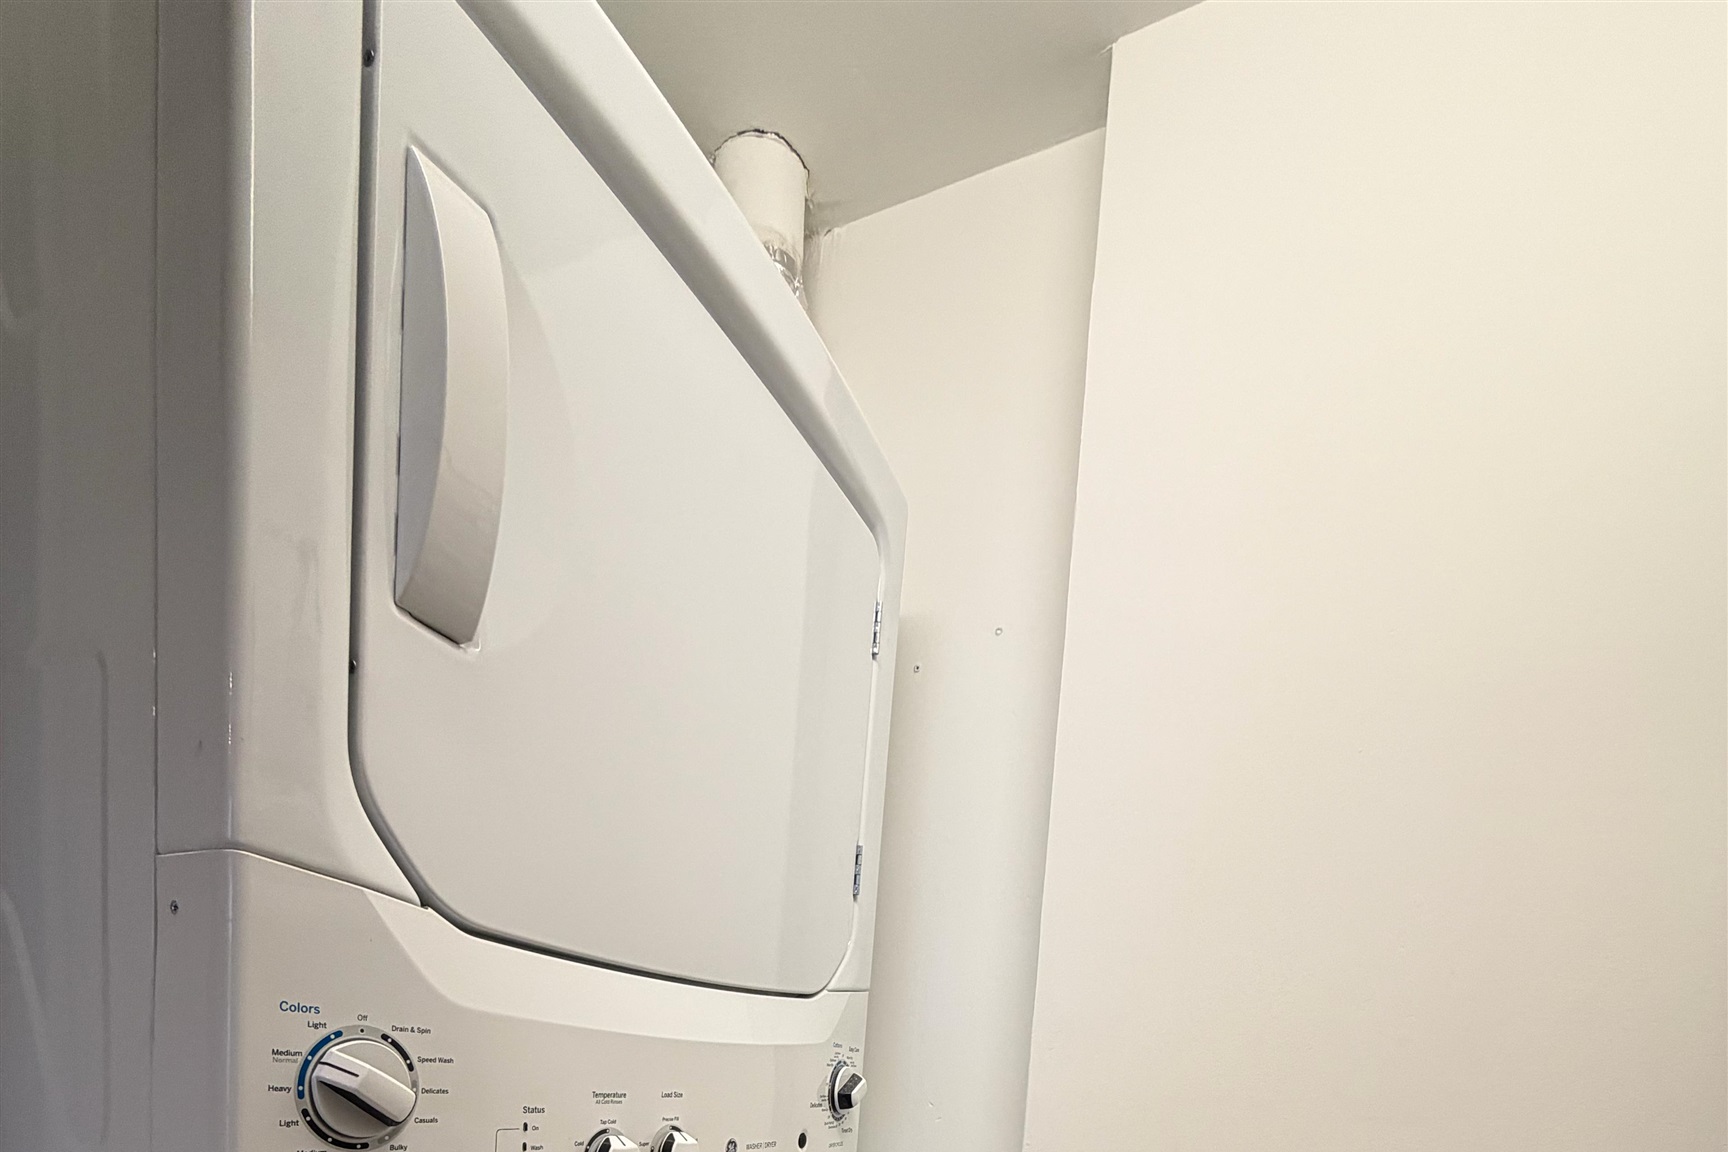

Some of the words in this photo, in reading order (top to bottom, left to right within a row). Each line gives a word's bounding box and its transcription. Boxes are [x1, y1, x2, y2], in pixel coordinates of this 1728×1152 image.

[279, 1000, 321, 1014] Colors
[307, 1020, 327, 1029] Light
[391, 1025, 409, 1033] Drain
[416, 1026, 432, 1035] Spin
[271, 1048, 303, 1057] Medium
[272, 1056, 299, 1064] Normal
[417, 1056, 436, 1065] Speed
[267, 1085, 292, 1093] Heavy
[421, 1087, 449, 1095] Delicates
[592, 1091, 627, 1100] Temperature
[522, 1105, 546, 1115] Status
[279, 1119, 300, 1129] Light
[531, 1124, 540, 1132] On
[389, 1144, 408, 1152] Bulky
